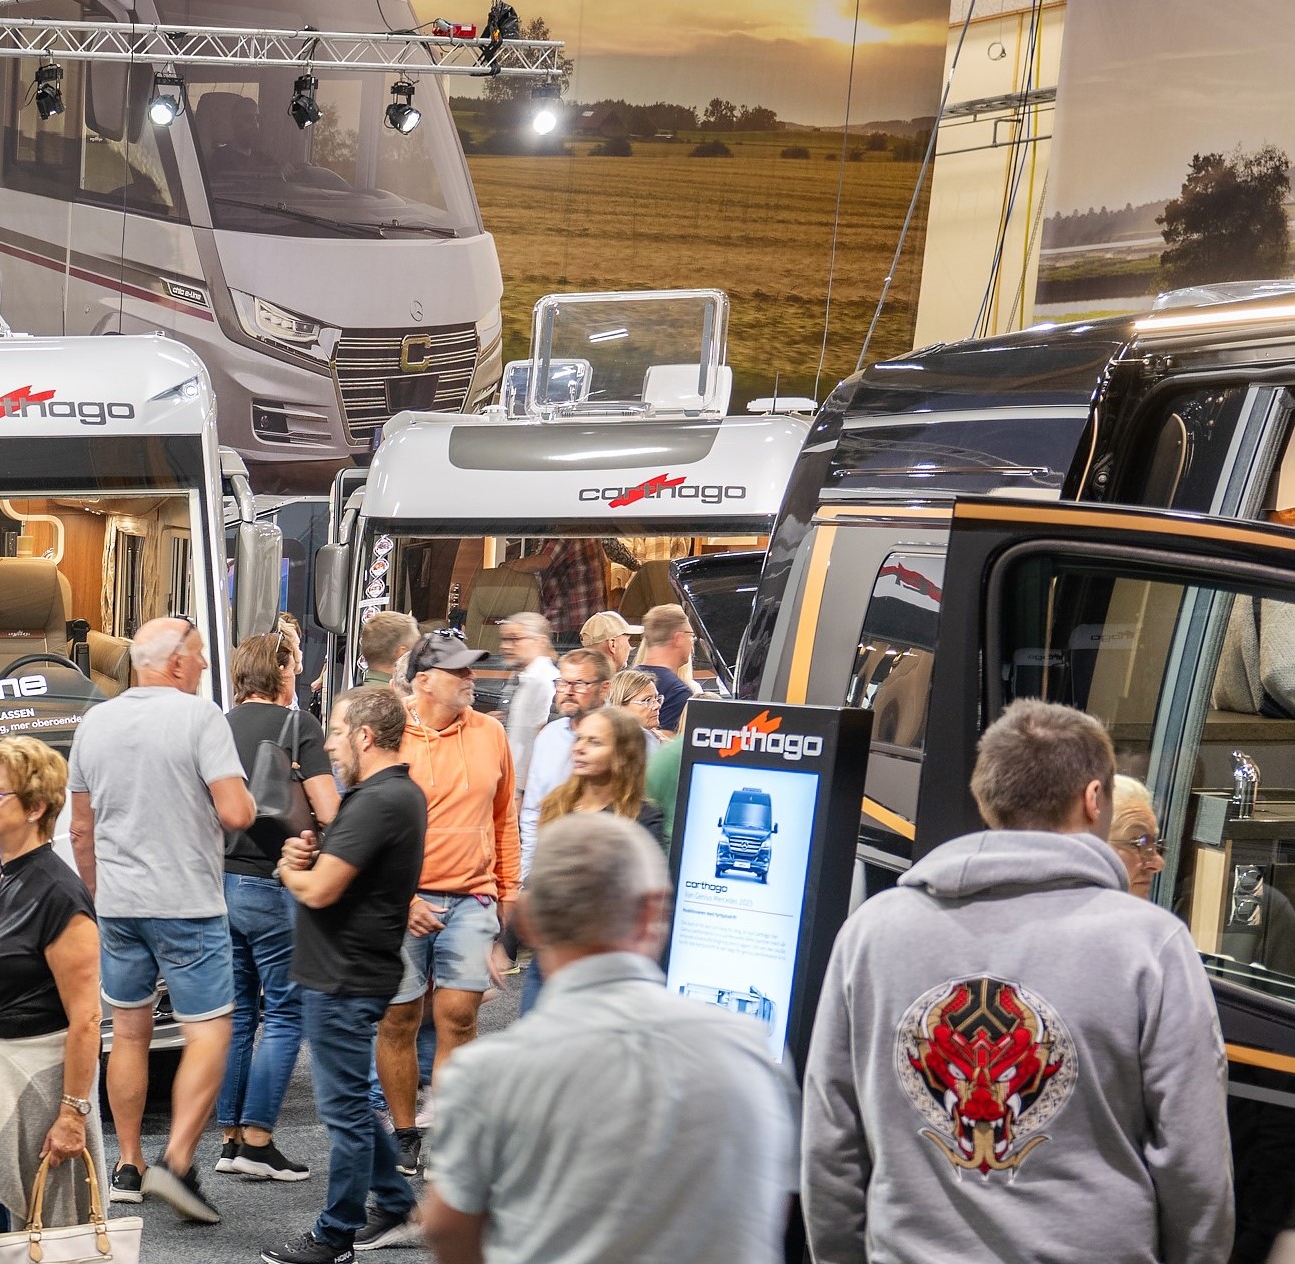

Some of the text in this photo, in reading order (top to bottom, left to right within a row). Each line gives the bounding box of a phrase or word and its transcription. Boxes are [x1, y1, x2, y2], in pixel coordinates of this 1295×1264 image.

[578, 483, 747, 504] carthago
[10, 721, 30, 731] mer
[31, 714, 82, 729] oberoende
[691, 725, 824, 761] carthago
[685, 880, 728, 894] carthago
[334, 1250, 352, 1264] HOKA
